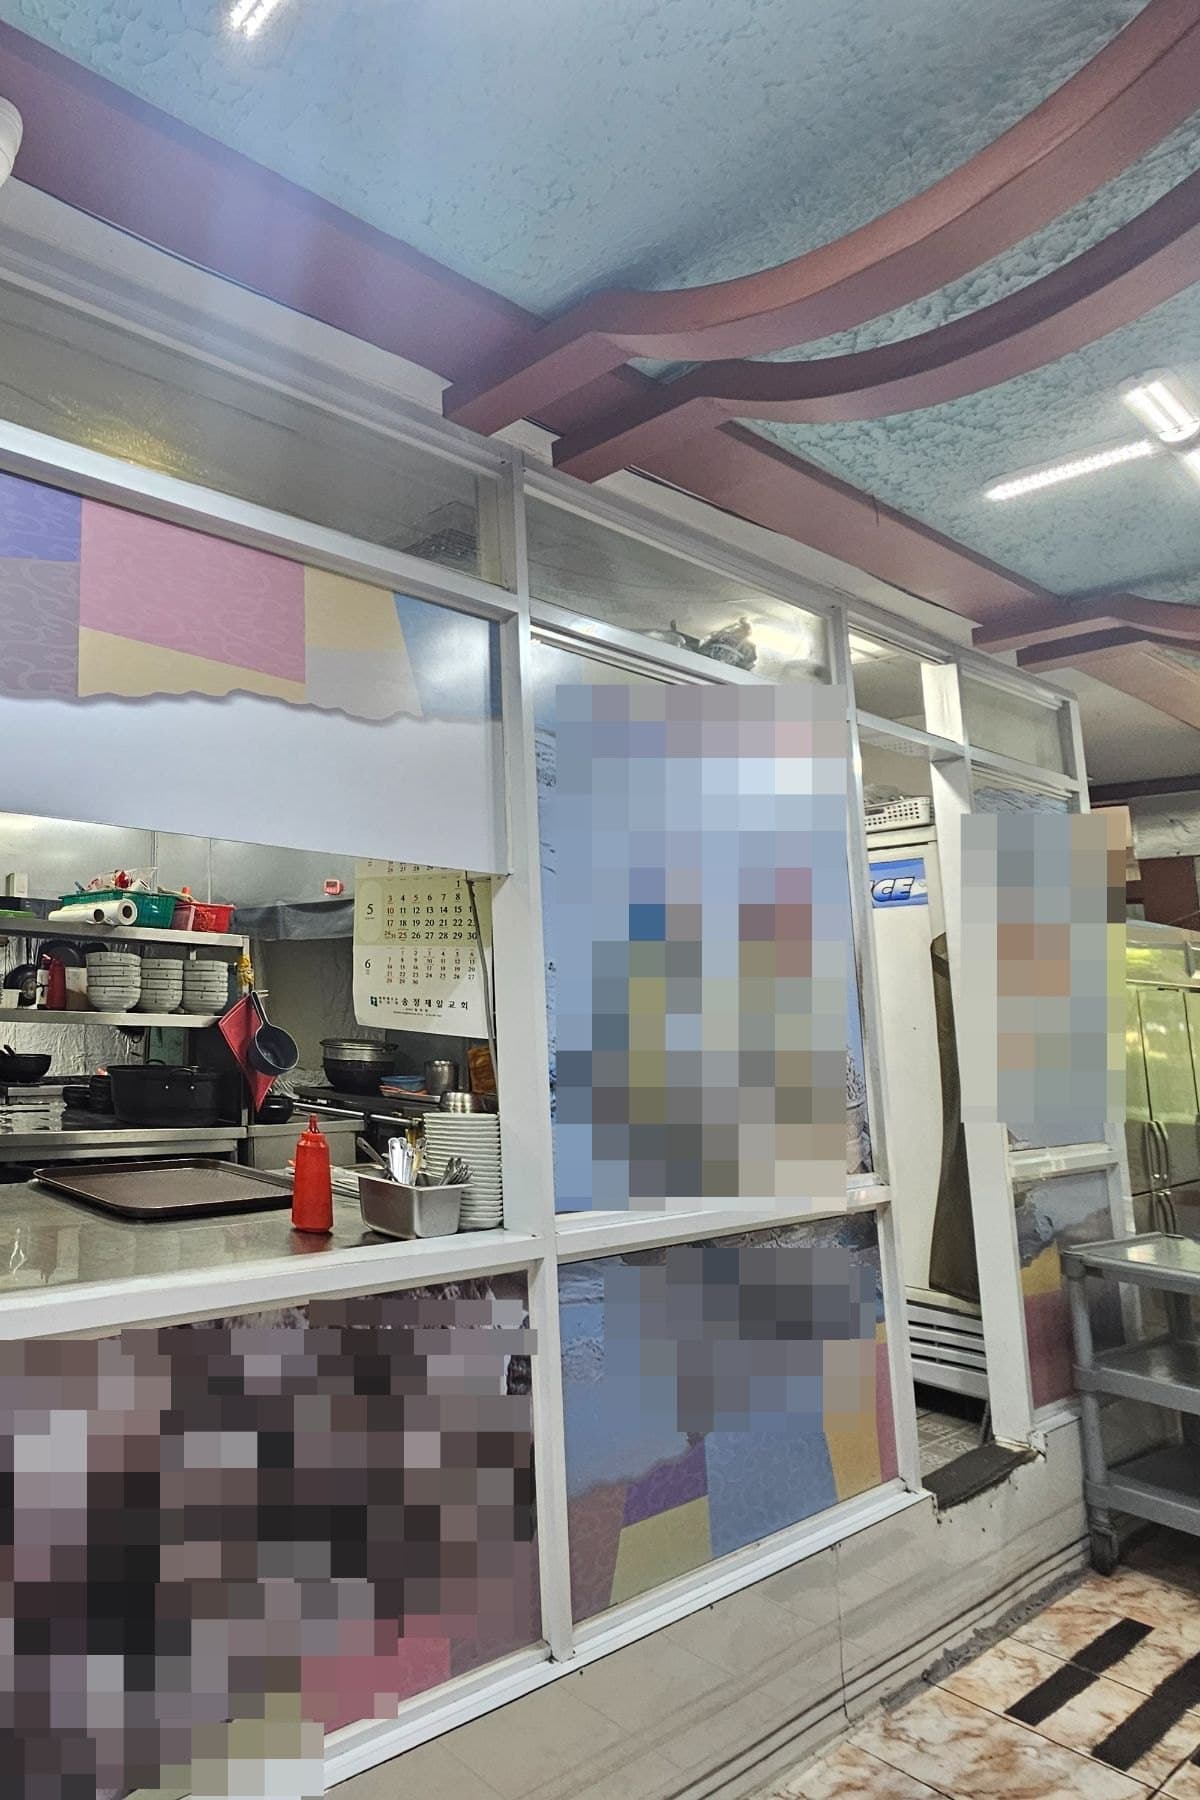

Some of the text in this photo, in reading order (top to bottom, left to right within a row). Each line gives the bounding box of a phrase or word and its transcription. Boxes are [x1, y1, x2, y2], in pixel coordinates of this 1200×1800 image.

[441, 893, 446, 901] 7
[366, 903, 374, 915] 5
[440, 906, 448, 914] 14
[364, 959, 371, 969] 6
